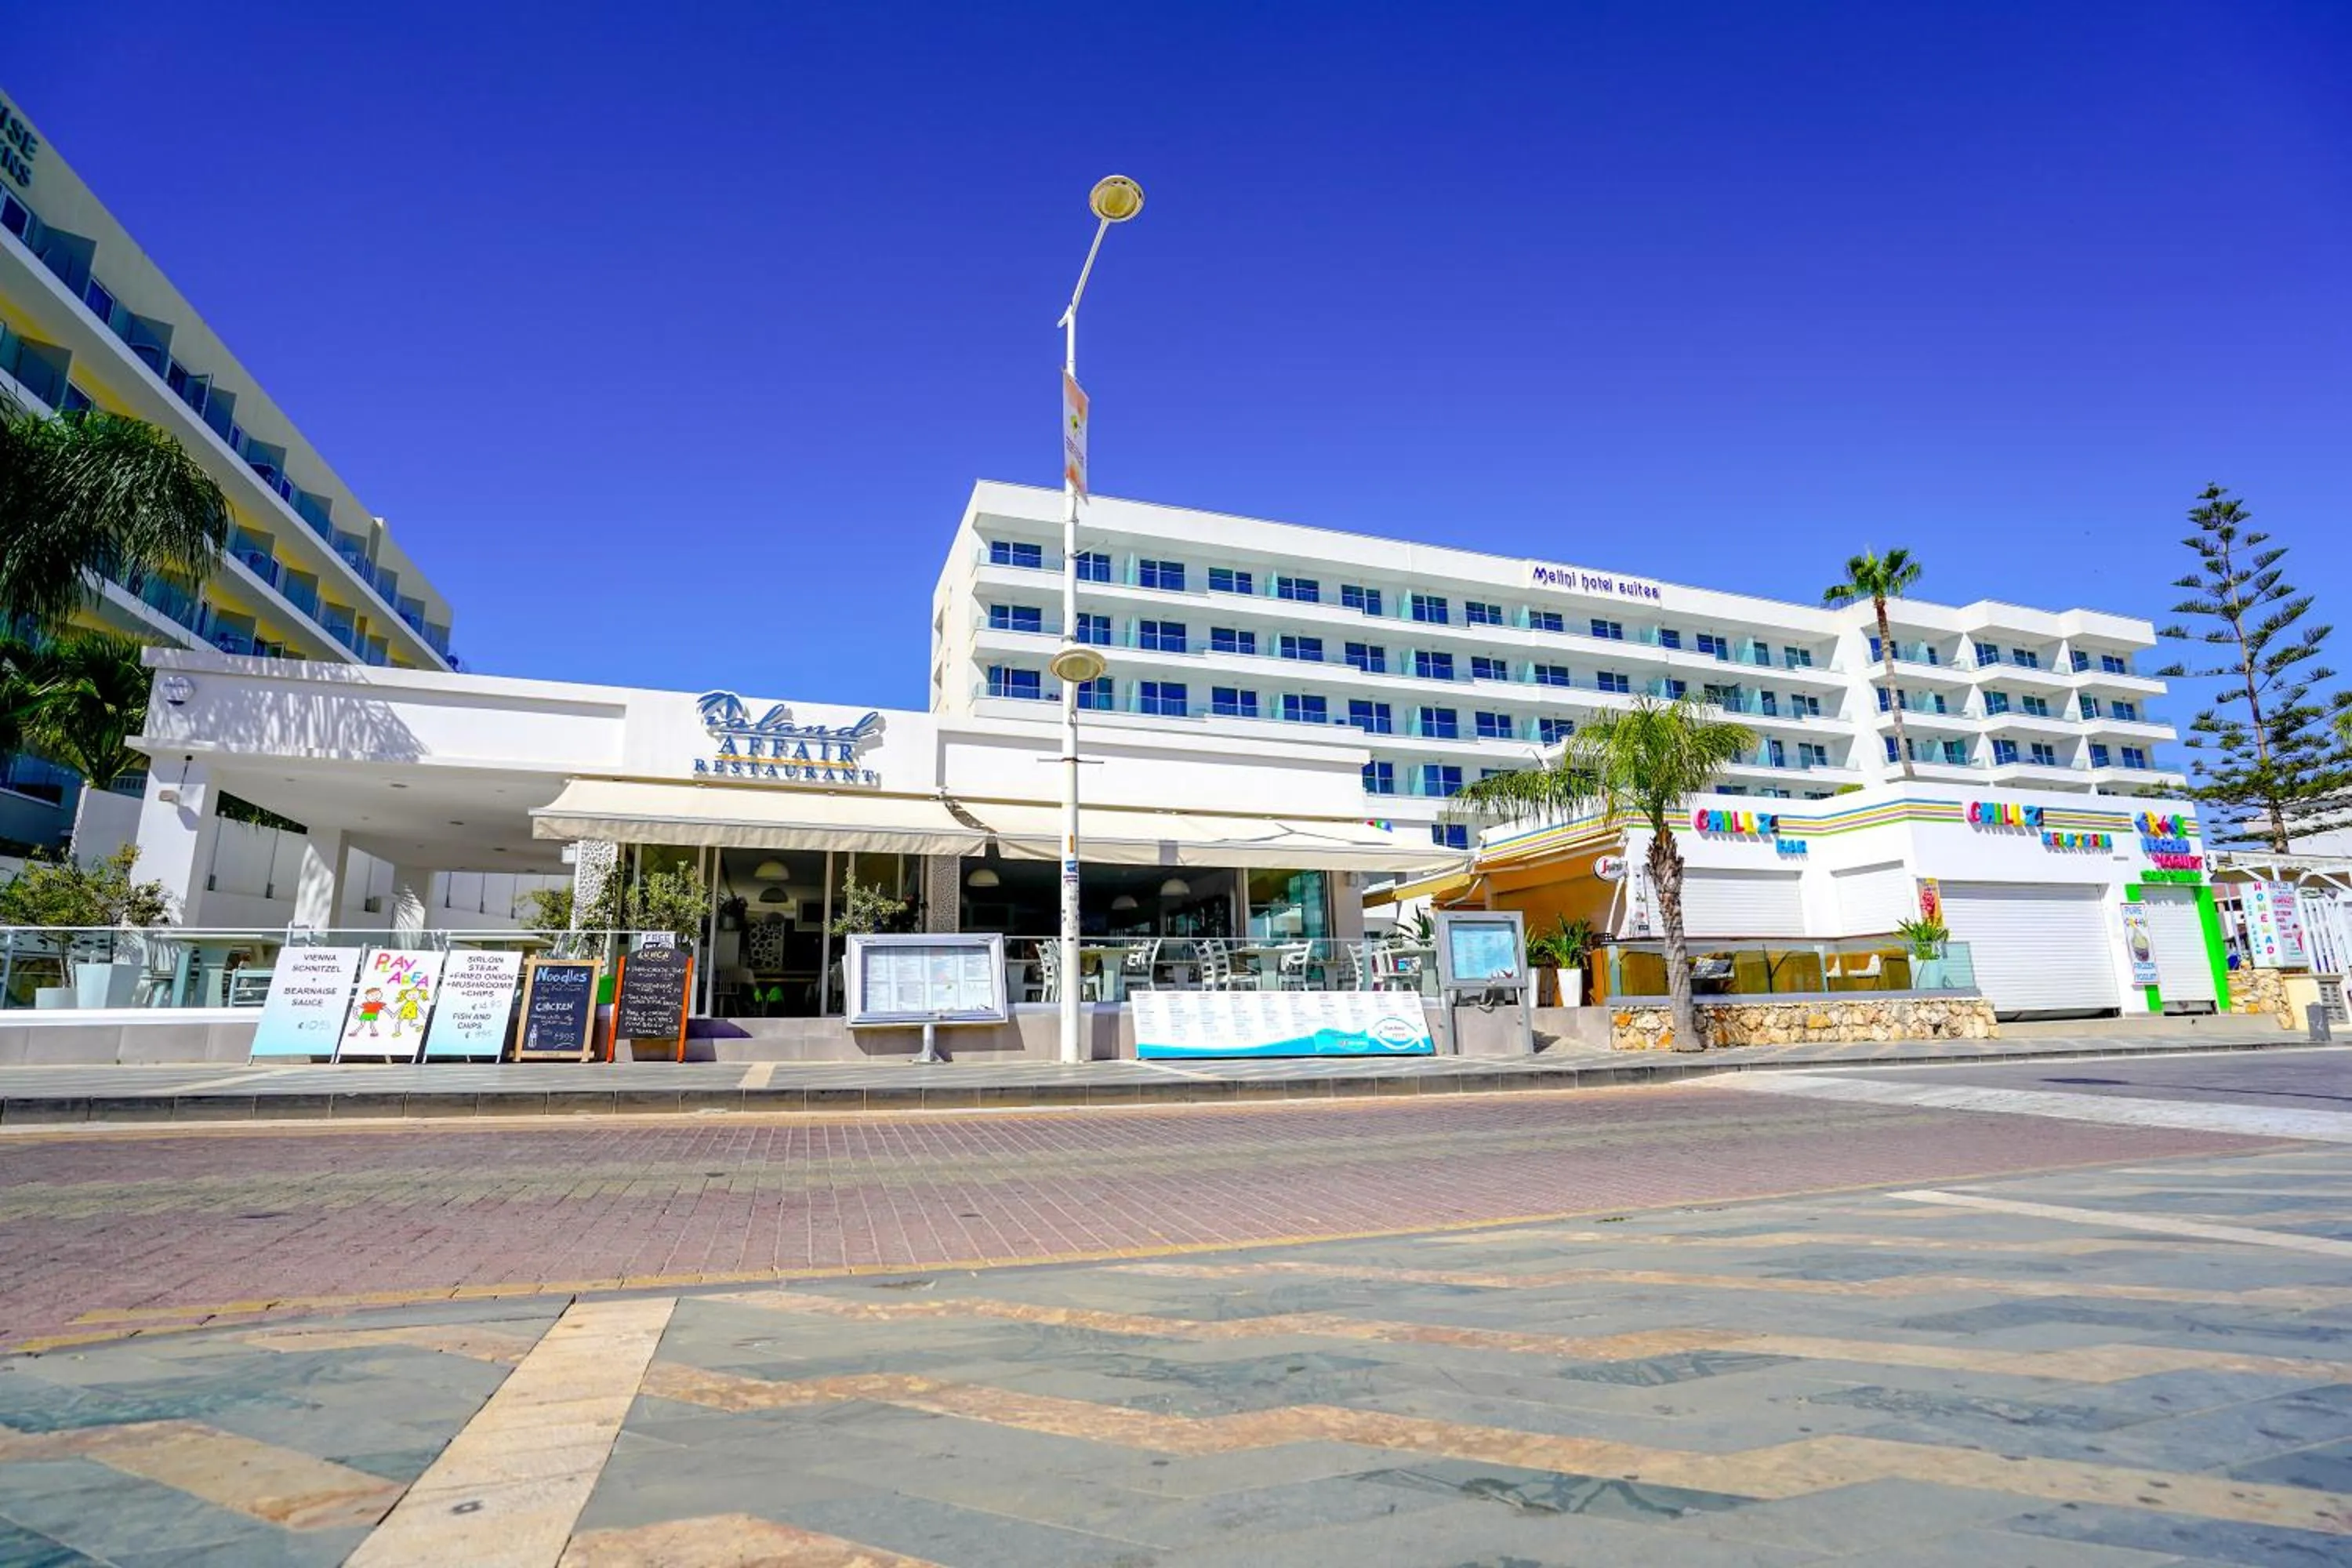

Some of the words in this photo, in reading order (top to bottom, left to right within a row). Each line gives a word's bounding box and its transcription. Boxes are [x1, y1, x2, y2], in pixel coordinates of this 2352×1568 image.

[0, 138, 32, 187] NS
[1581, 573, 1613, 592] hotel
[1619, 582, 1660, 600] suites
[719, 735, 854, 764] AFFAIR
[694, 757, 877, 782] RESTAURANT
[1777, 838, 1806, 853] BAR
[292, 964, 342, 973] SCHNITZEL
[535, 967, 588, 985] Noodles
[292, 998, 324, 1007] SAUCE
